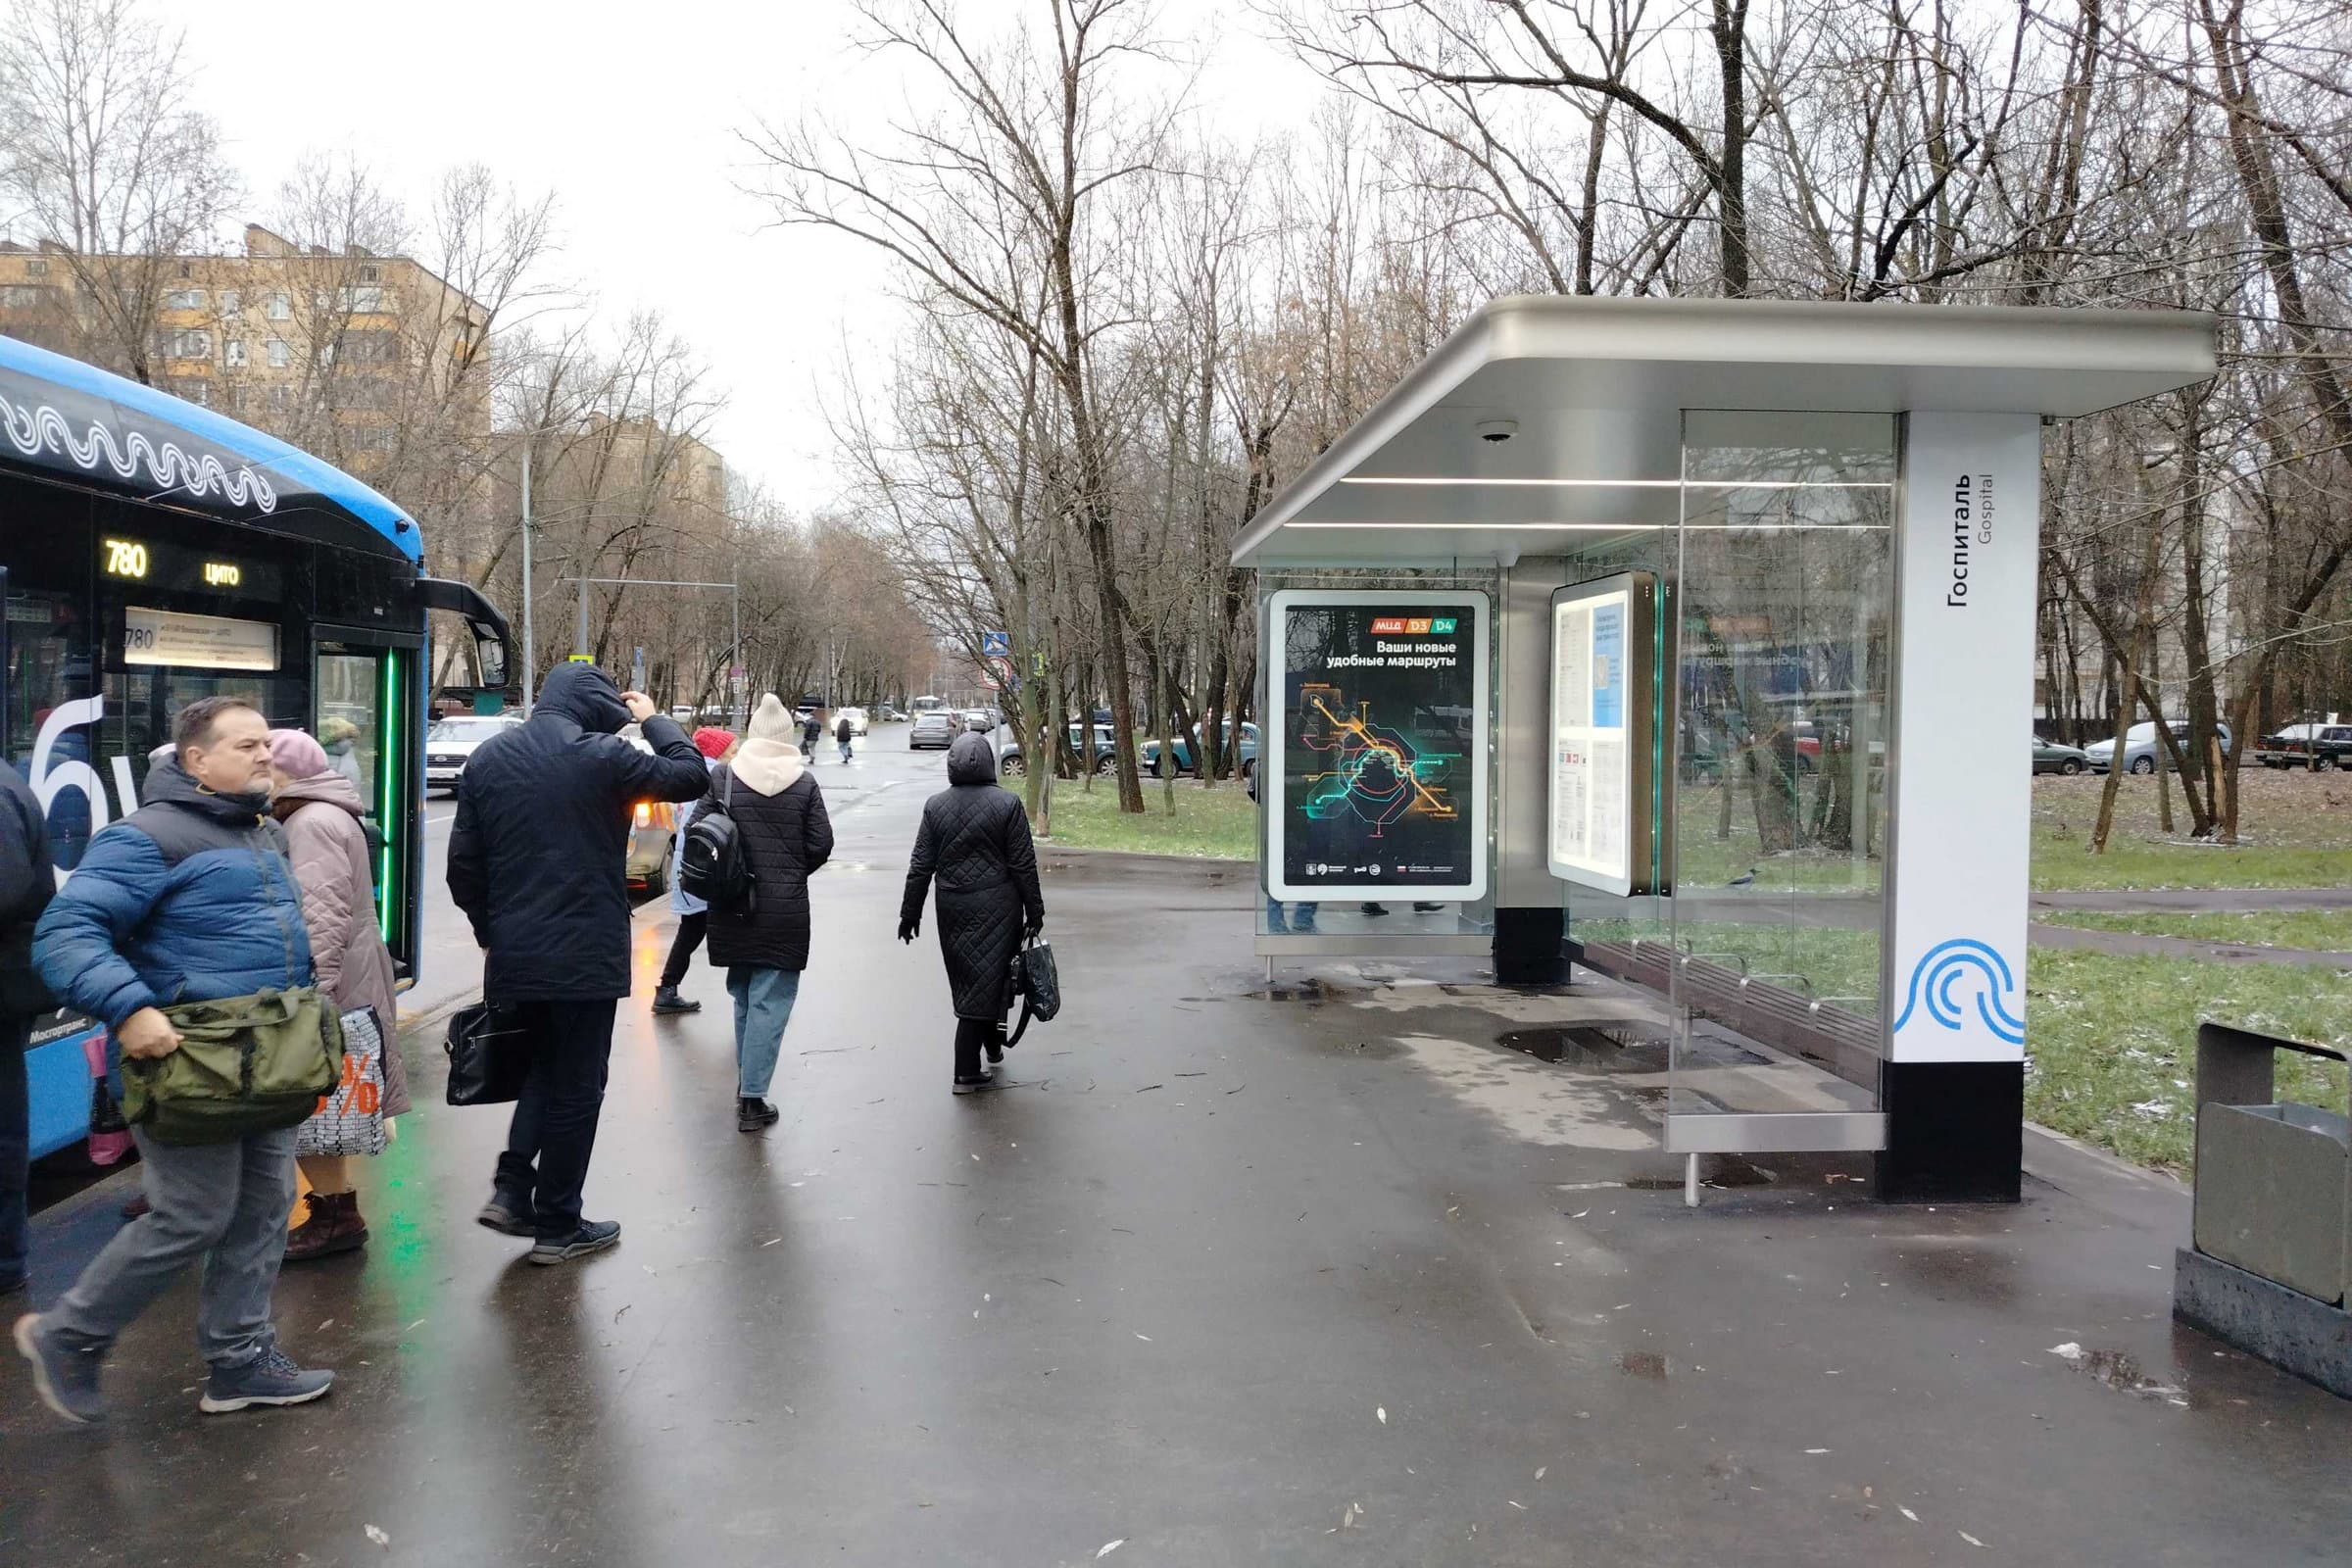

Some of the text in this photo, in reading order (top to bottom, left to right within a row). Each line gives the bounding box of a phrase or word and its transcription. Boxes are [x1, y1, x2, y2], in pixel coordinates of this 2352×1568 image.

[1978, 474, 1995, 545] Gospital
[1947, 474, 1971, 608] Госпиталь
[105, 540, 239, 585] 780 ЦИТО
[1375, 619, 1453, 630] МЦД D3 D4
[124, 627, 154, 650] 780
[1376, 641, 1457, 654] Ваши новые
[1326, 654, 1456, 669] удобные маршруты
[29, 1018, 87, 1044] Мосгортранс
